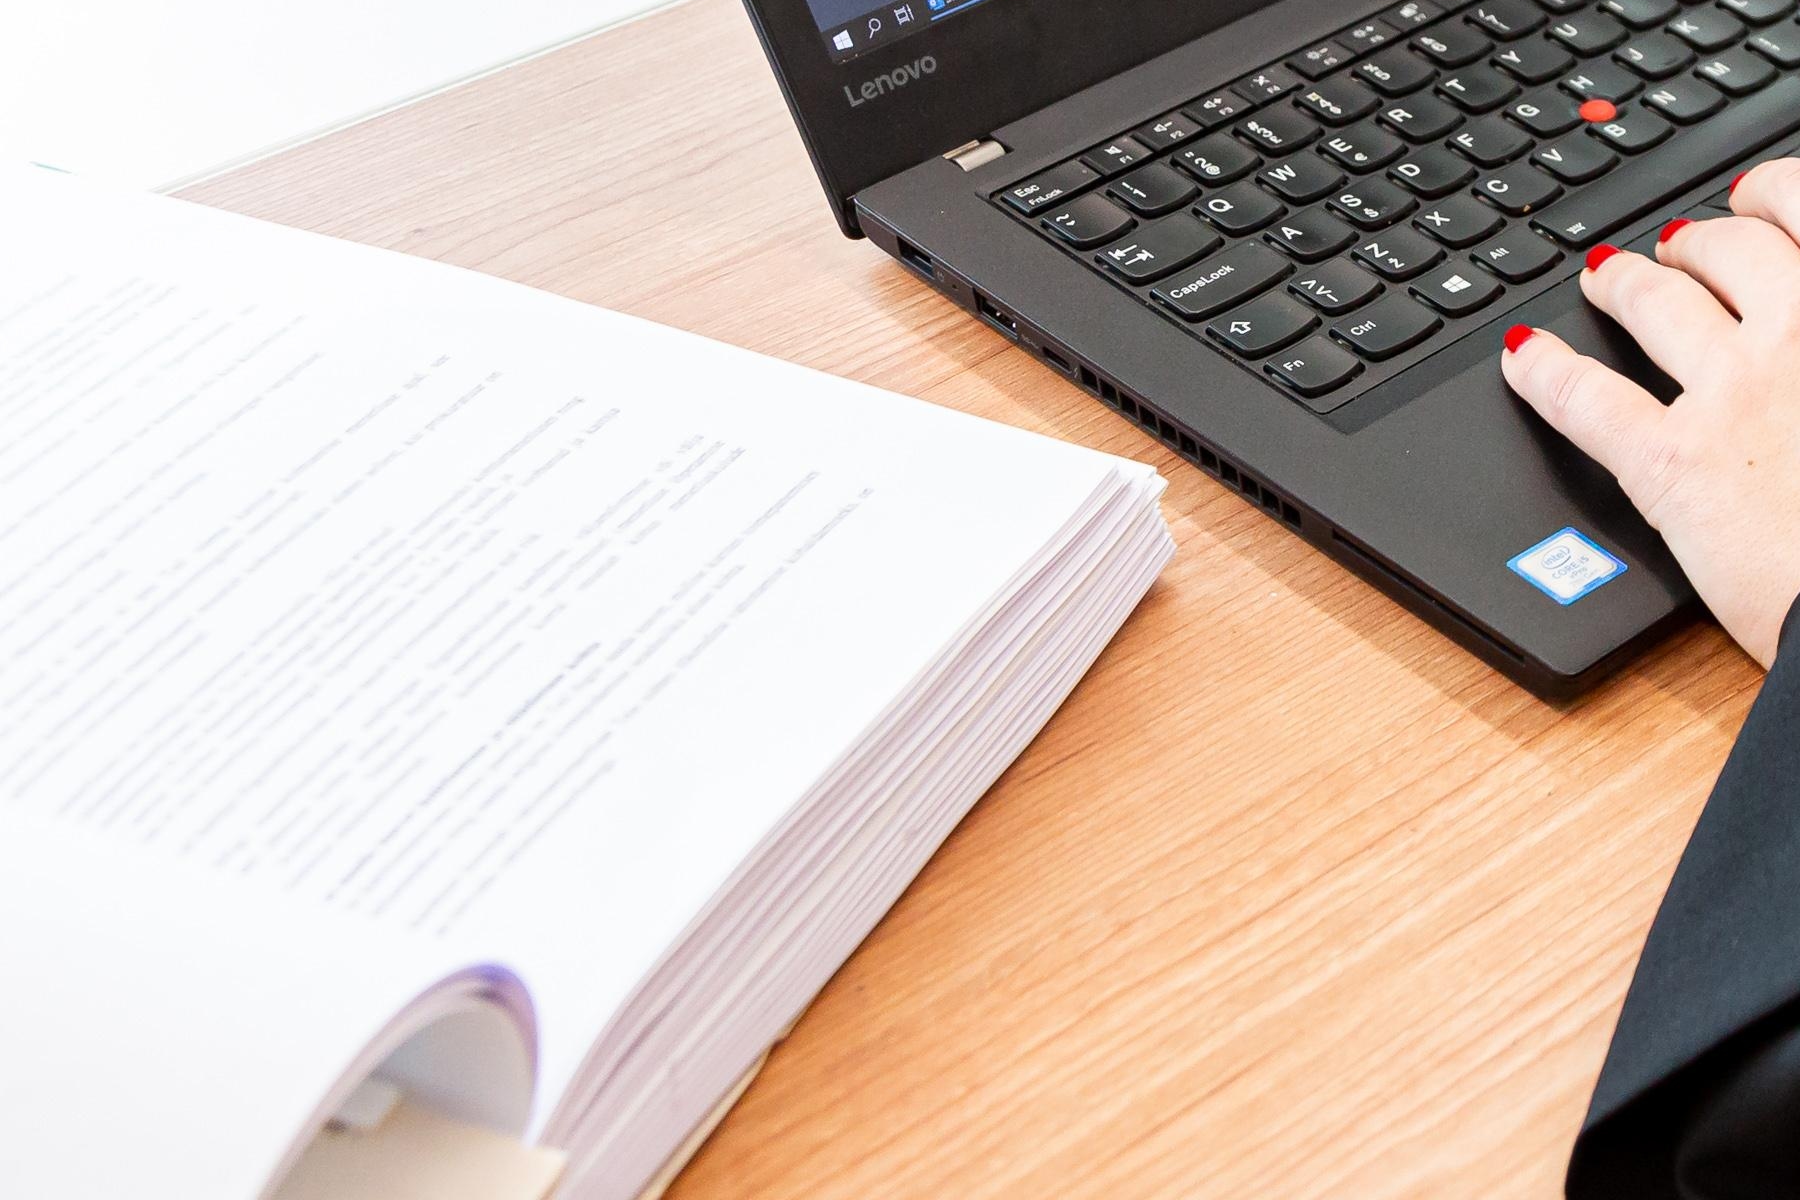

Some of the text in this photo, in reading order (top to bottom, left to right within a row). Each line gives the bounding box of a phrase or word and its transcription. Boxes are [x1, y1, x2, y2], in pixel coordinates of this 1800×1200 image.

[1555, 23, 1578, 37] U
[1675, 19, 1699, 34] K
[1500, 50, 1521, 63] Y
[1628, 47, 1644, 61] J
[1704, 61, 1730, 76] M
[843, 55, 937, 107] Lenovo
[1444, 78, 1466, 91] T
[1569, 75, 1594, 90] H
[1651, 90, 1677, 105] N
[1387, 108, 1413, 122] R
[1516, 103, 1540, 117] G
[1169, 129, 1185, 139] F2
[1603, 123, 1626, 138] B
[1328, 137, 1353, 153] E
[1456, 132, 1474, 148] F
[1118, 154, 1133, 164] F1
[1541, 148, 1563, 162] V
[1194, 157, 1212, 169] 2
[1397, 163, 1421, 177] D
[1267, 164, 1296, 181] W
[1013, 184, 1040, 198] Esc
[1486, 179, 1509, 193] C
[1028, 188, 1063, 206] FnLock
[1339, 193, 1362, 207] S
[1207, 198, 1234, 213] Q
[1424, 210, 1451, 227] X
[1280, 226, 1303, 240] A
[1363, 242, 1389, 258] Z
[1489, 247, 1510, 260] Alt
[1169, 265, 1234, 298] CapsLock
[1350, 320, 1377, 336] Ctrl
[1282, 359, 1305, 371] Fn
